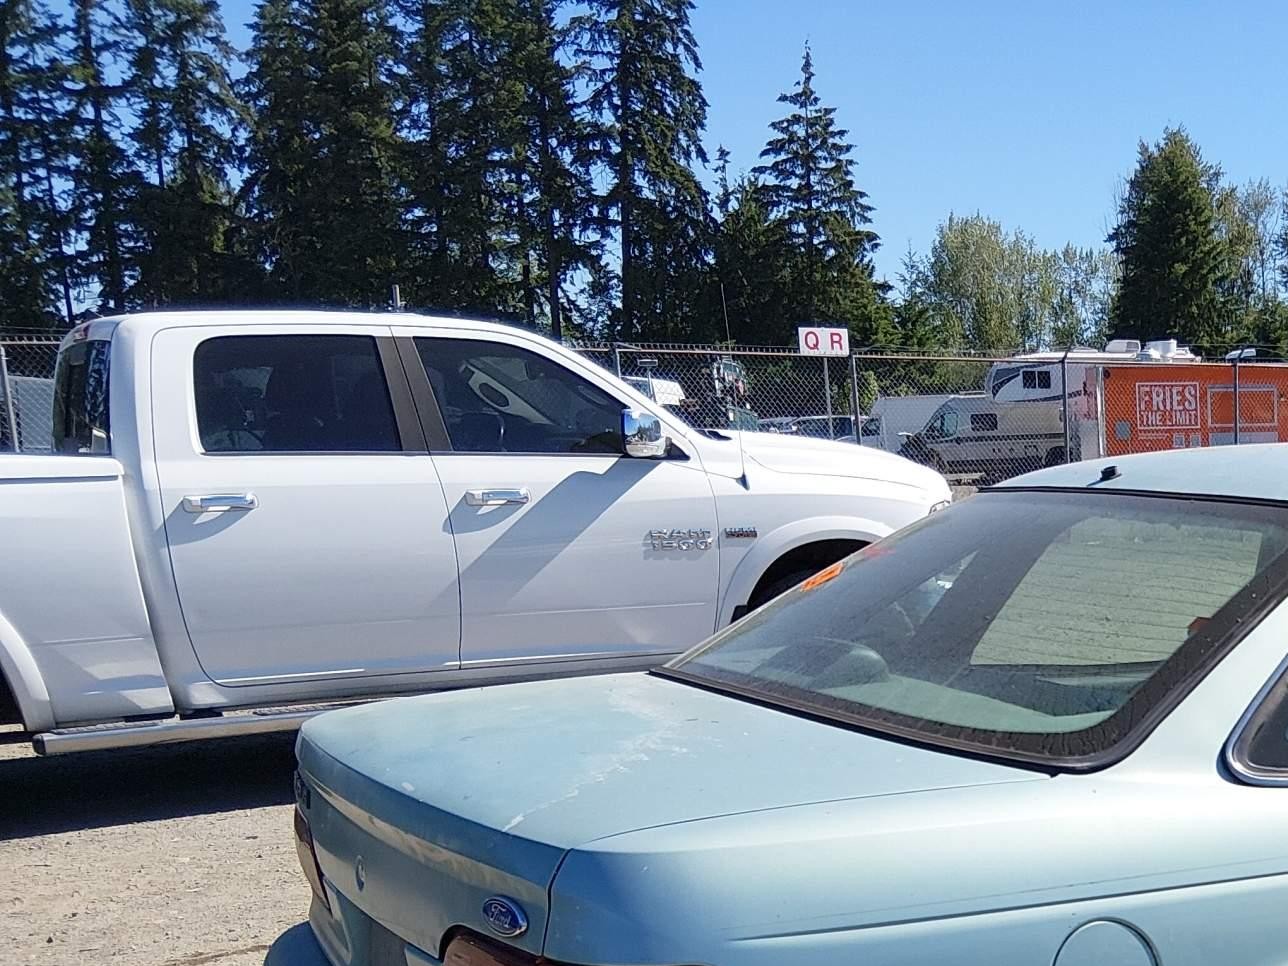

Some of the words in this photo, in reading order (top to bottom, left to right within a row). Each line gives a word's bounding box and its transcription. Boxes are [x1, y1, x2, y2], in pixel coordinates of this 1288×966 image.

[804, 331, 820, 350] Q
[829, 333, 844, 350] R
[1138, 385, 1197, 411] FRIES
[1140, 411, 1163, 426] THE
[1165, 411, 1197, 426] LIMIT
[489, 903, 514, 929] Ford
